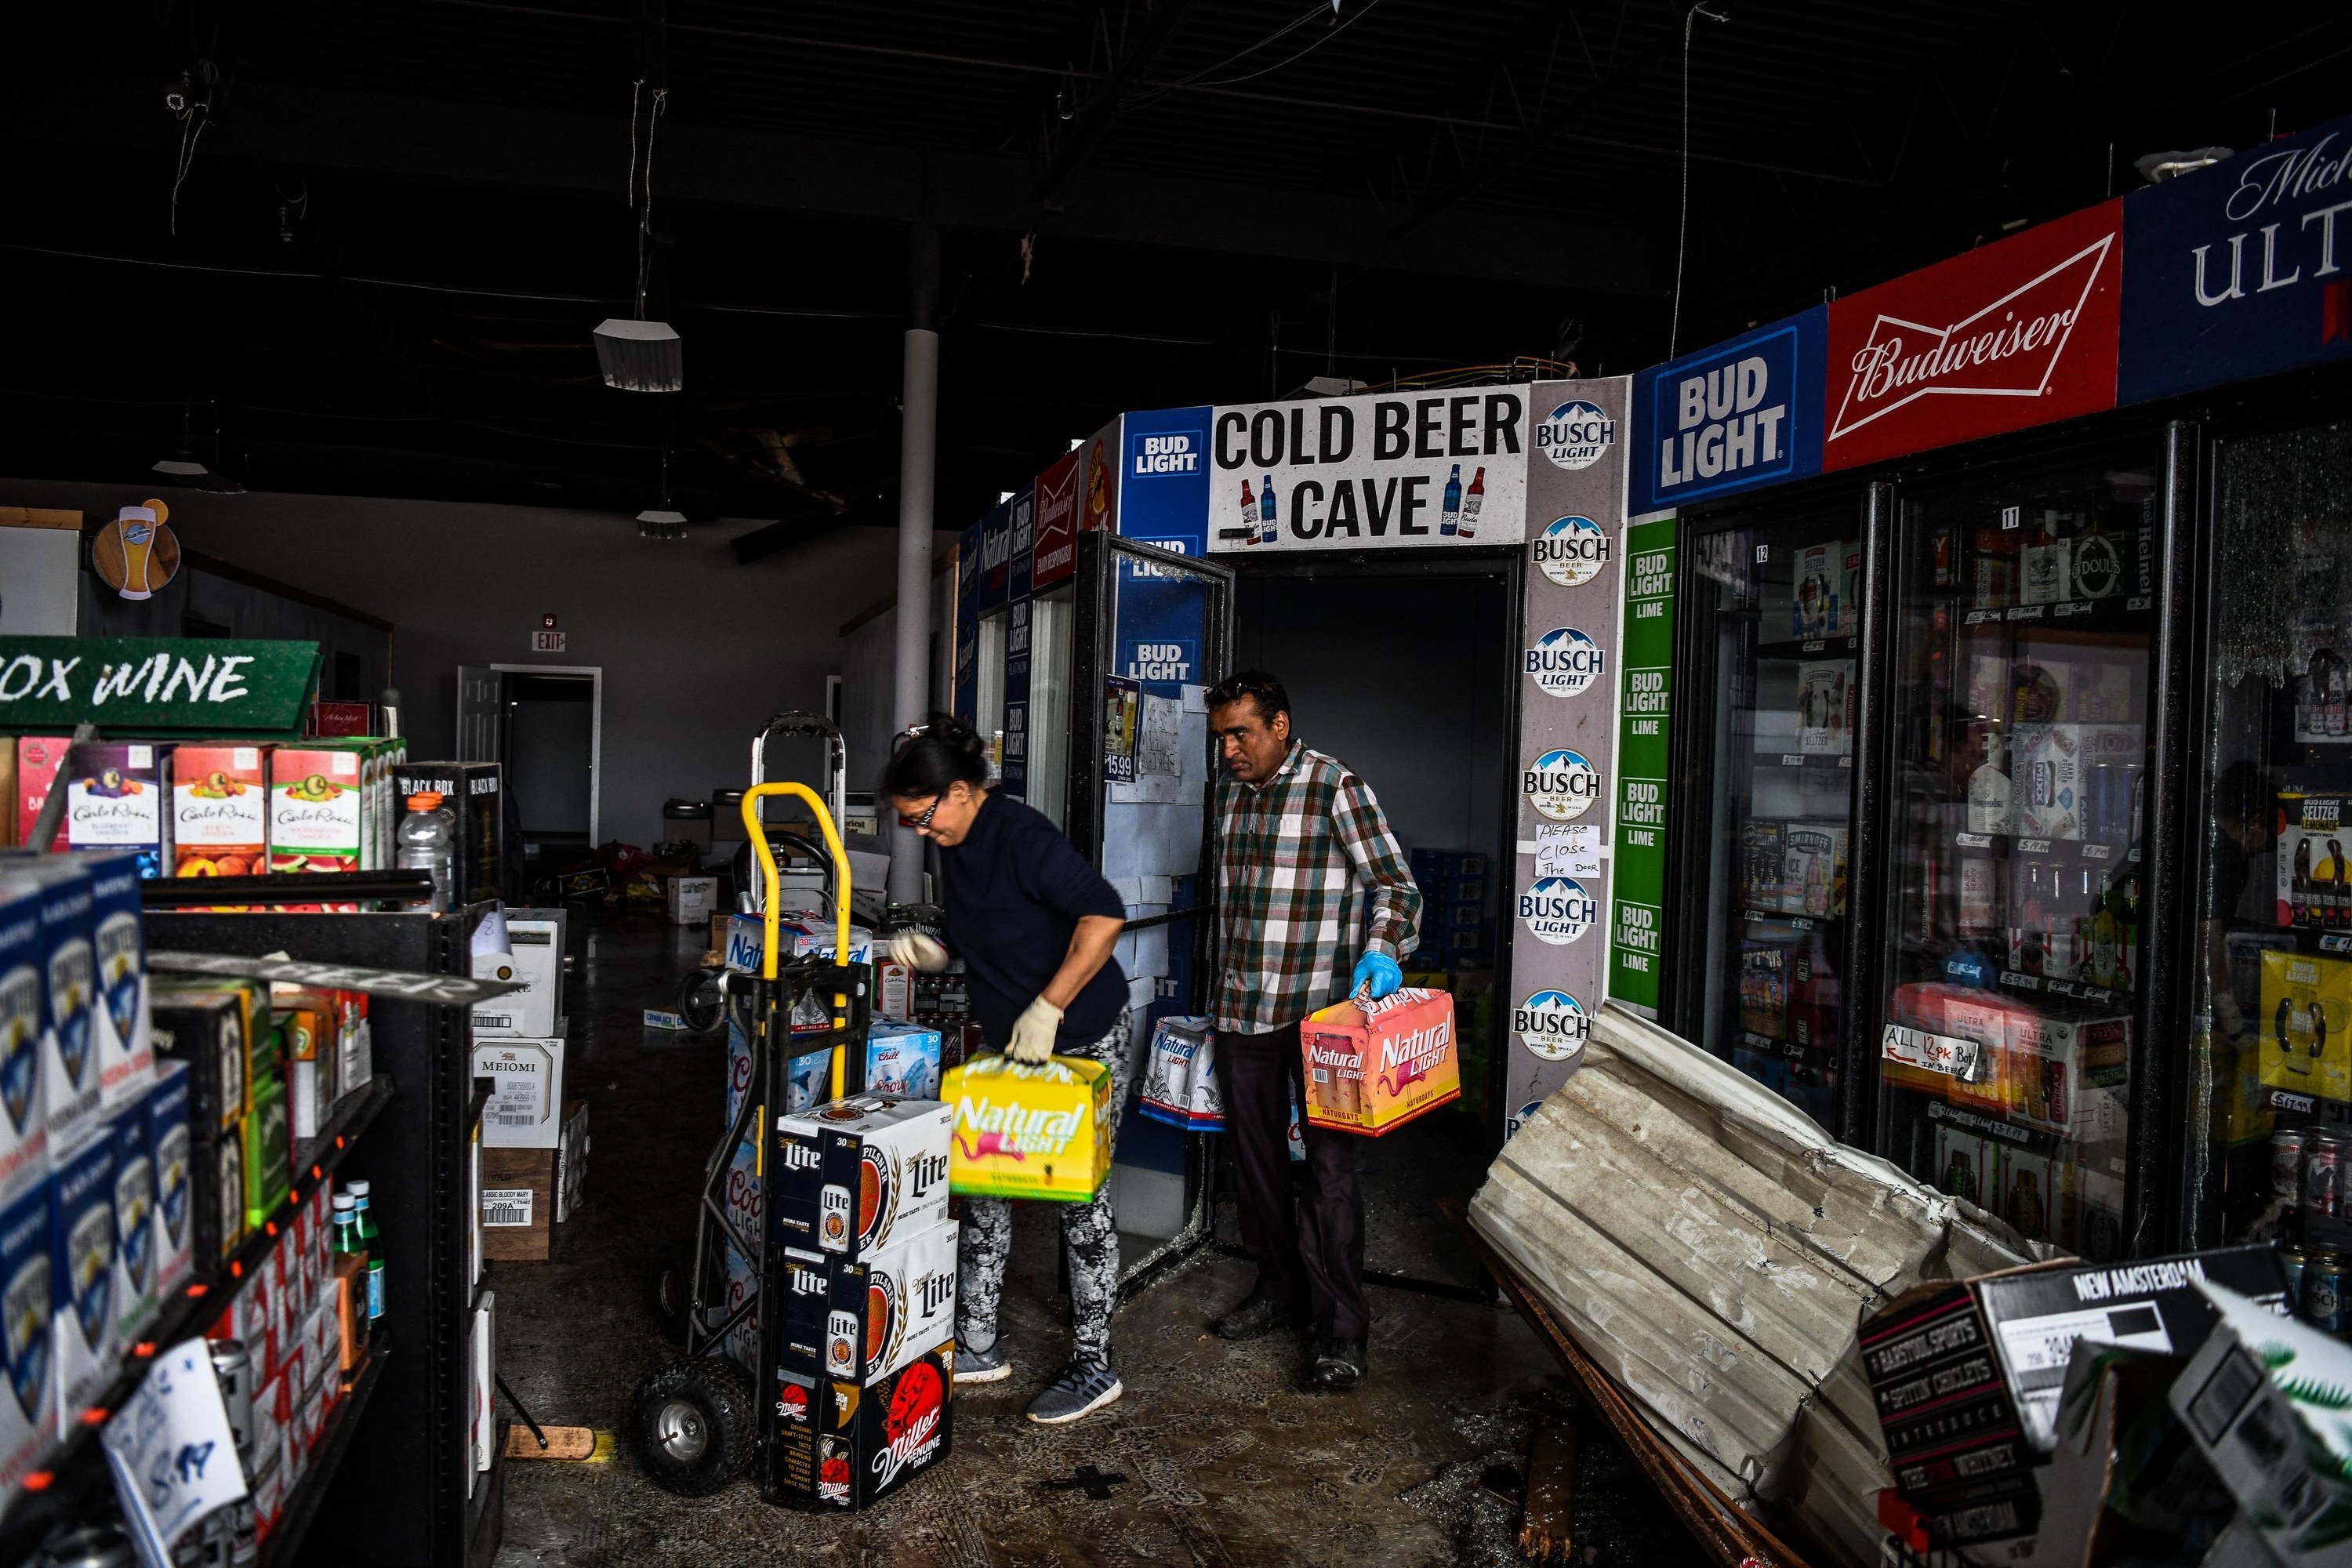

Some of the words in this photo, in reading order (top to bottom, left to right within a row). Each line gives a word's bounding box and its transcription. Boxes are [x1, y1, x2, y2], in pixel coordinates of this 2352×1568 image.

[2192, 200, 2352, 307] ULT
[1852, 309, 2074, 403] Budweiser
[1678, 356, 1767, 431] BUD
[1215, 405, 1354, 470] COLD
[1374, 394, 1522, 461] BEER
[1537, 420, 1615, 448] BUSCH
[1145, 436, 1189, 455] BUD
[1552, 446, 1598, 458] LIGHT
[1661, 405, 1785, 488] LIGHT
[1136, 454, 1196, 474] LIGHT
[1016, 501, 1029, 525] BUD
[1290, 476, 1430, 540] CAVE
[2005, 510, 2016, 527] 11
[1013, 523, 1032, 554] LIGHT
[982, 528, 1009, 574] Natural
[1047, 543, 1072, 569] RESPONSIBLY
[1533, 539, 1611, 562] BUSCH
[1758, 547, 1767, 561] 12
[1636, 554, 1667, 576] BUD
[1630, 573, 1672, 596] LIGHT
[1013, 602, 1026, 626] BUD
[1636, 602, 1663, 619] LIME
[538, 633, 562, 650] EXIT
[1009, 626, 1028, 652] LIGHT
[1138, 644, 1181, 662] BUD
[1526, 650, 1604, 673] BUSCH
[0, 655, 82, 702] OX
[93, 653, 255, 705] WINE
[1129, 662, 1189, 681] LIGHT
[1541, 675, 1587, 685] LIGHT
[1632, 673, 1663, 692] BUD
[1626, 691, 1668, 712] LIGHT
[1009, 708, 1023, 731] BUD
[1632, 720, 1659, 735] LIME
[1006, 731, 1025, 756] LIGHT
[401, 779, 431, 796] BLACK
[435, 779, 454, 796] BOX
[471, 778, 488, 795] BLACK
[488, 777, 498, 793] BOX
[1523, 771, 1602, 797] BUSCH
[1628, 783, 1659, 803] BUD
[74, 802, 110, 822] Carlo
[180, 805, 216, 822] Carlo
[1622, 801, 1664, 824] LIGHT
[2302, 806, 2339, 820] SELTZER
[2301, 820, 2339, 831] LEMONADE
[1628, 830, 1654, 846] LIME
[1789, 833, 1828, 848] SMIRNOFF
[1543, 862, 1565, 876] The
[1788, 858, 1801, 873] ICE
[1519, 895, 1597, 923] BUSCH
[1622, 906, 1653, 929] BUD
[898, 924, 915, 935] JACK
[915, 923, 942, 937] DANIEL'S
[1534, 920, 1581, 934] LIGHT
[1617, 923, 1657, 950] LIGHT
[1622, 953, 1649, 972] LIME
[1514, 1009, 1591, 1040] BUSCH
[1958, 1014, 1984, 1028] ULTRA
[1379, 1011, 1452, 1073] Natural
[1886, 1027, 1918, 1049] ALL
[2019, 1040, 2039, 1048] ORGANIC
[2020, 1028, 2053, 1044] ULTRA
[1154, 1033, 1199, 1059] Natural
[799, 1057, 811, 1066] 30
[878, 1051, 900, 1061] Chill
[1167, 1054, 1190, 1068] LIGHT
[1308, 1044, 1364, 1069] Natural
[1410, 1044, 1449, 1077] LIGHT
[482, 1062, 535, 1072] MEIOMI
[1337, 1069, 1367, 1080] LIGHT
[1936, 1064, 1958, 1075] BEER
[1406, 1090, 1435, 1109] NATURDAYS
[953, 1094, 1087, 1138] Natural
[1322, 1108, 1359, 1121] NATURDAYS
[1389, 1112, 1414, 1128] STRAWBERRY
[1414, 1103, 1433, 1116] LEMONADE
[837, 1138, 848, 1147] 30
[1000, 1132, 1073, 1155] LIGHT
[784, 1142, 822, 1171] Lite
[863, 1147, 888, 1185] PILSNER
[906, 1149, 926, 1174] Miller
[911, 1154, 948, 1198] Lite
[823, 1192, 848, 1210] Lite
[898, 1211, 909, 1221] MORE
[909, 1207, 920, 1216] TASTE
[844, 1264, 854, 1273] 30
[791, 1268, 827, 1296] Lite
[870, 1273, 895, 1308] PILSNER
[912, 1269, 935, 1296] Miller
[2073, 1272, 2112, 1302] NEW
[921, 1272, 955, 1318] Lite
[2310, 1294, 2340, 1308] SCH
[830, 1317, 856, 1336] Lite
[907, 1333, 918, 1342] MORE
[918, 1327, 930, 1336] TASTE
[1929, 1316, 1977, 1352] SPORTS
[775, 1401, 807, 1416] Miller
[781, 1429, 812, 1443] DRAFT-STYLE
[790, 1424, 812, 1434] ORIGINAL
[798, 1441, 811, 1450] TASTE
[871, 1406, 940, 1494] Miller
[906, 1434, 941, 1465] GENUINE
[785, 1456, 811, 1469] CHARACTER
[789, 1450, 812, 1461] BRINGING
[913, 1451, 933, 1469] DRAFT
[790, 1473, 811, 1484] MOMENT
[796, 1466, 811, 1476] EVERY
[784, 1478, 797, 1487] SINCE
[817, 1481, 851, 1499] Miller
[833, 1494, 851, 1503] GENUINE
